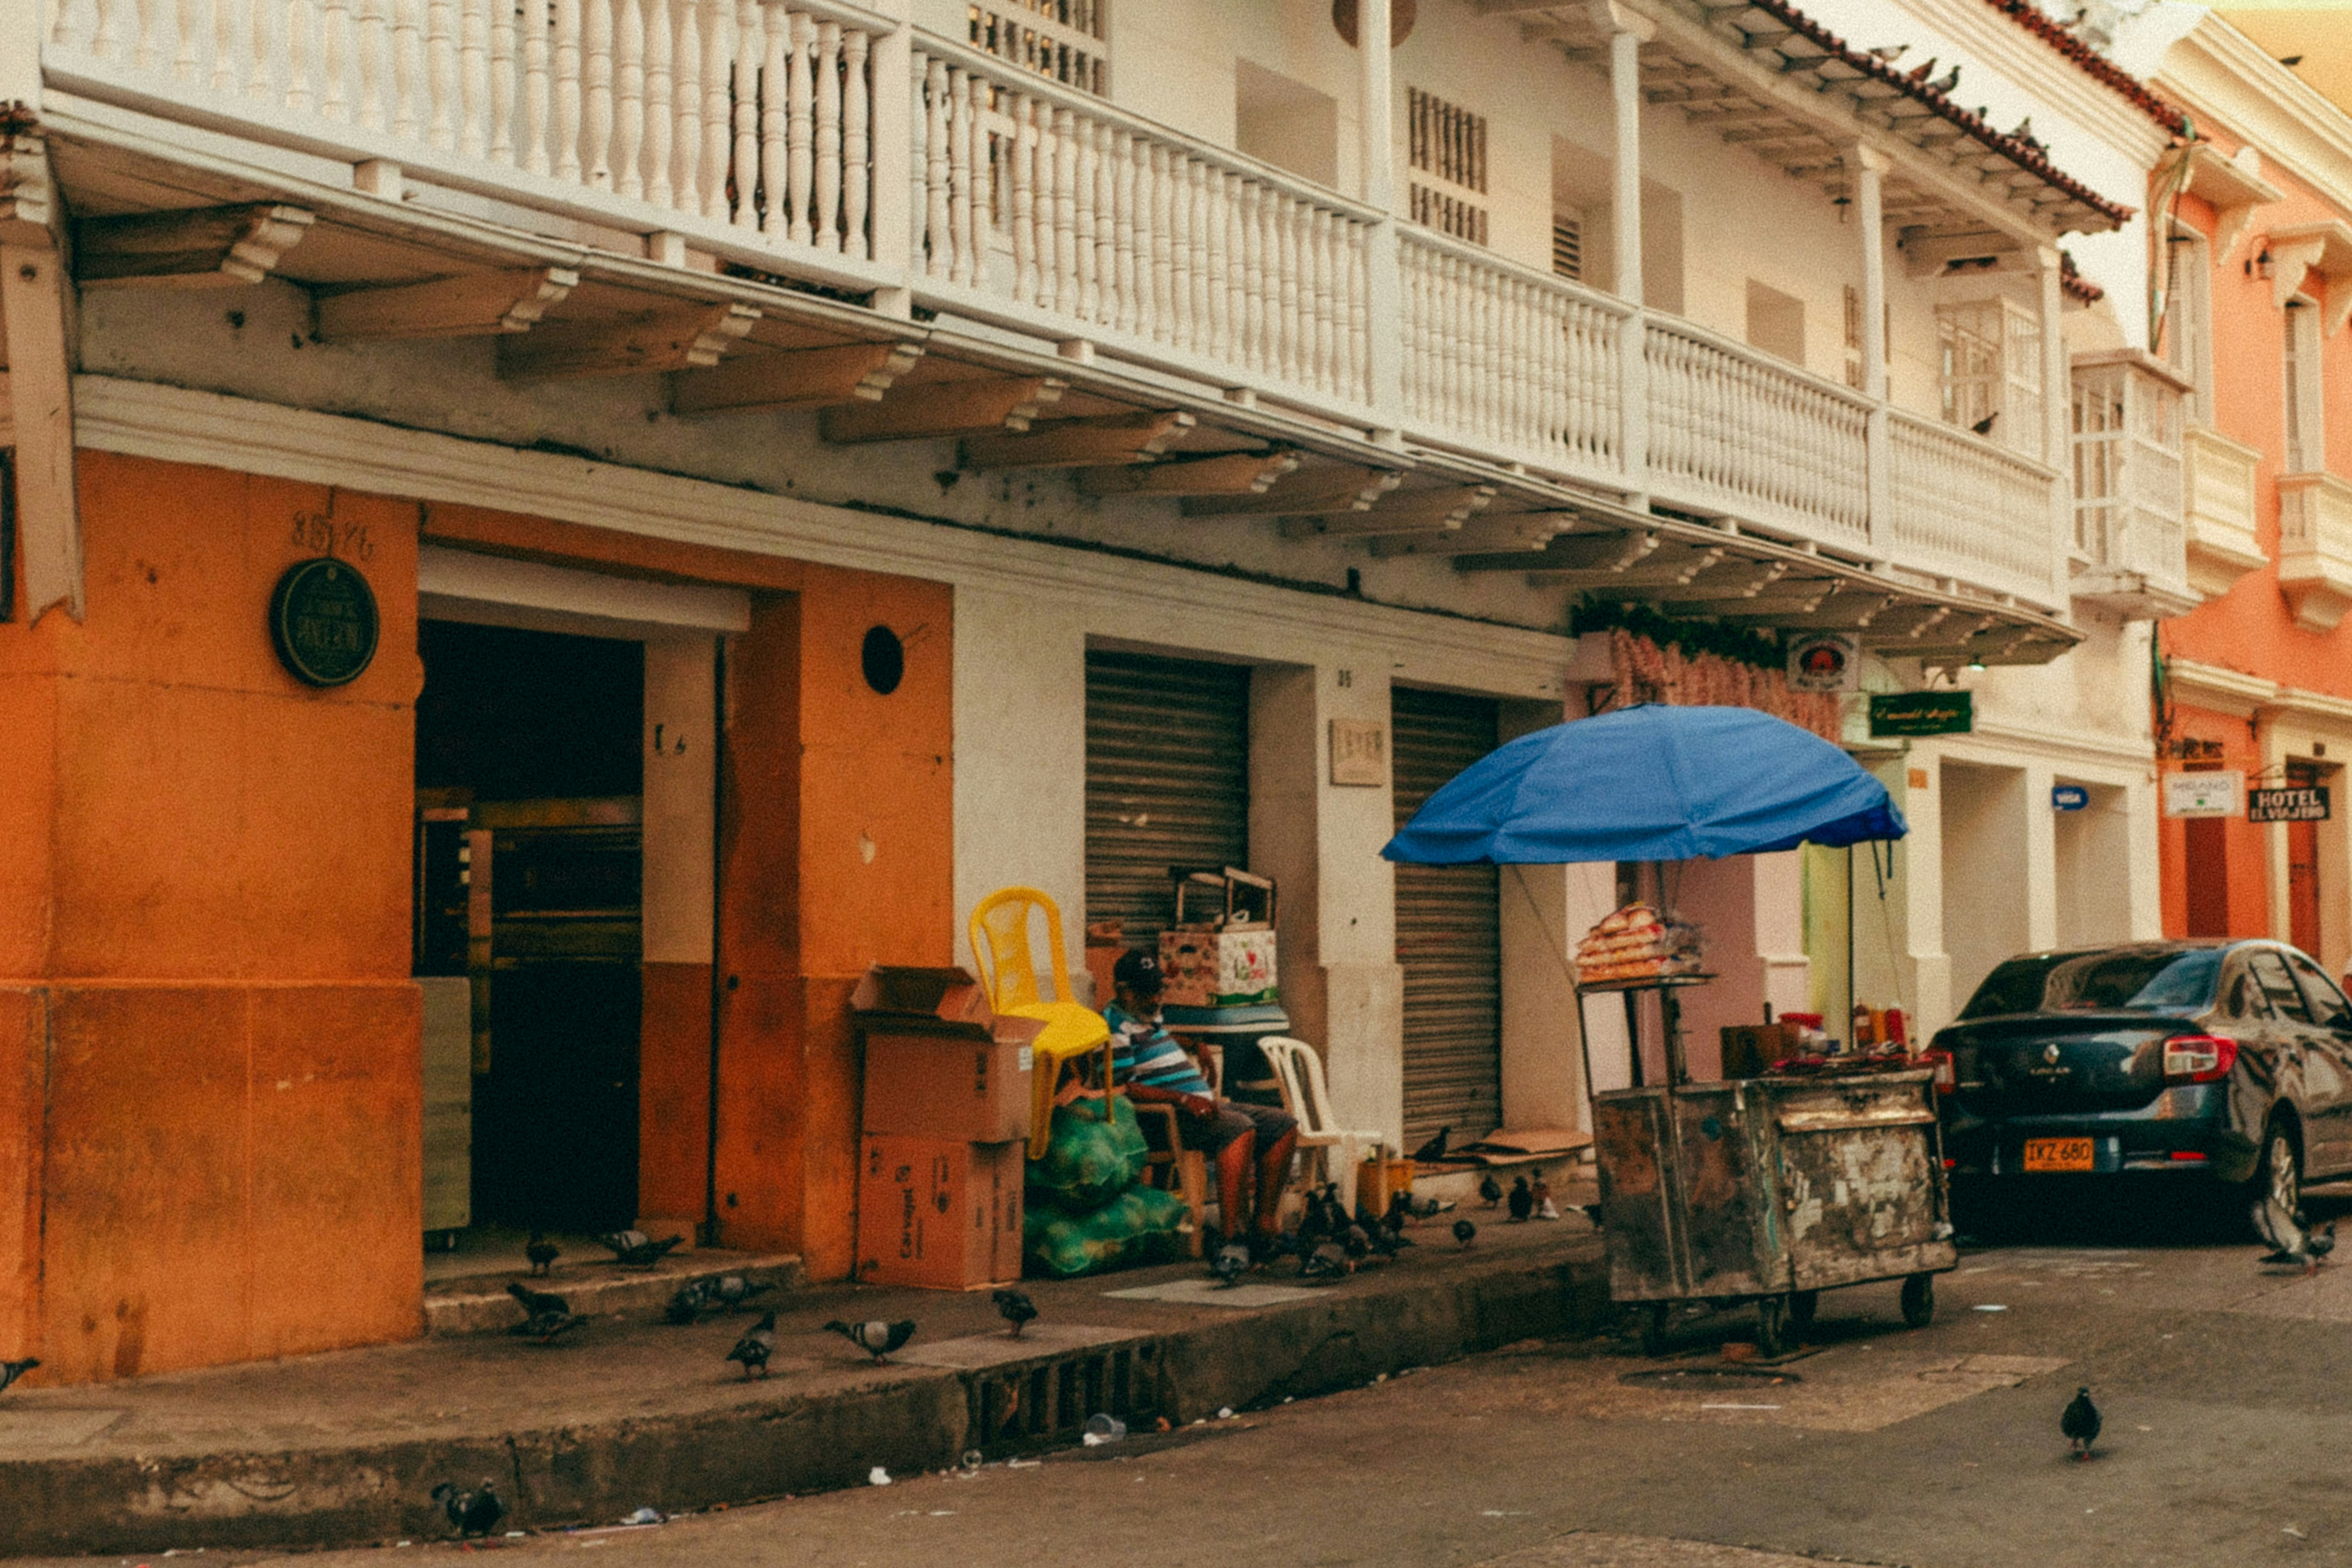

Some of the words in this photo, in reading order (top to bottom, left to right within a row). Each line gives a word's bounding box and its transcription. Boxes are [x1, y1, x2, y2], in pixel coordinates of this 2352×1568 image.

[2258, 790, 2320, 807] HOTEL
[2251, 808, 2266, 820] EL
[2060, 1142, 2090, 1161] 680
[901, 1188, 916, 1259] Carvajal
